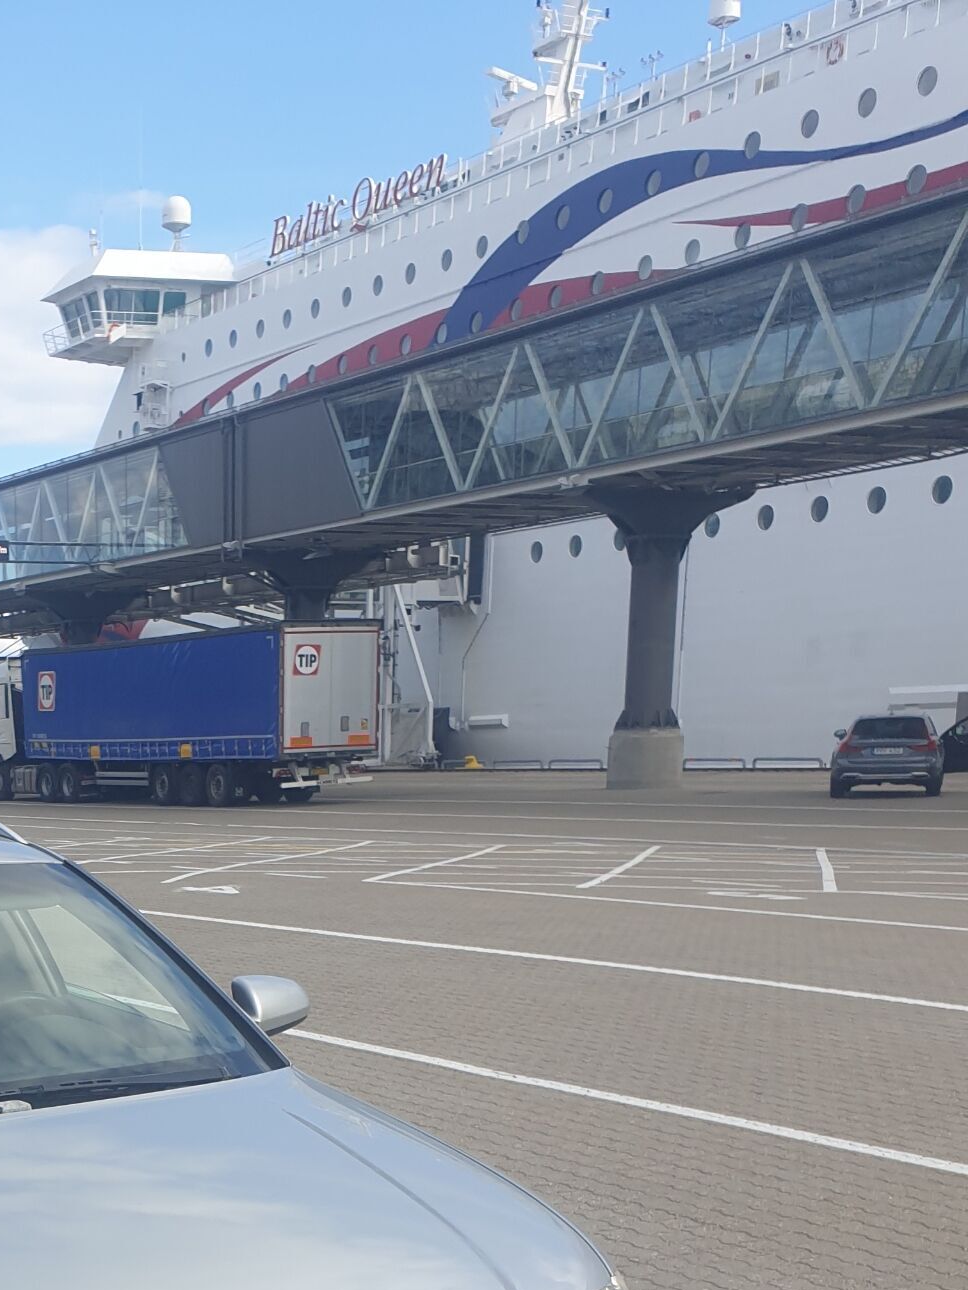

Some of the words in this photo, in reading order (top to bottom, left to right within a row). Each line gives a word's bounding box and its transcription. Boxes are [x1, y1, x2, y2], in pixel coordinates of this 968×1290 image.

[269, 194, 347, 258] Baltic
[349, 153, 448, 232] Queen
[297, 653, 317, 668] TIP
[41, 684, 53, 701] TIP
